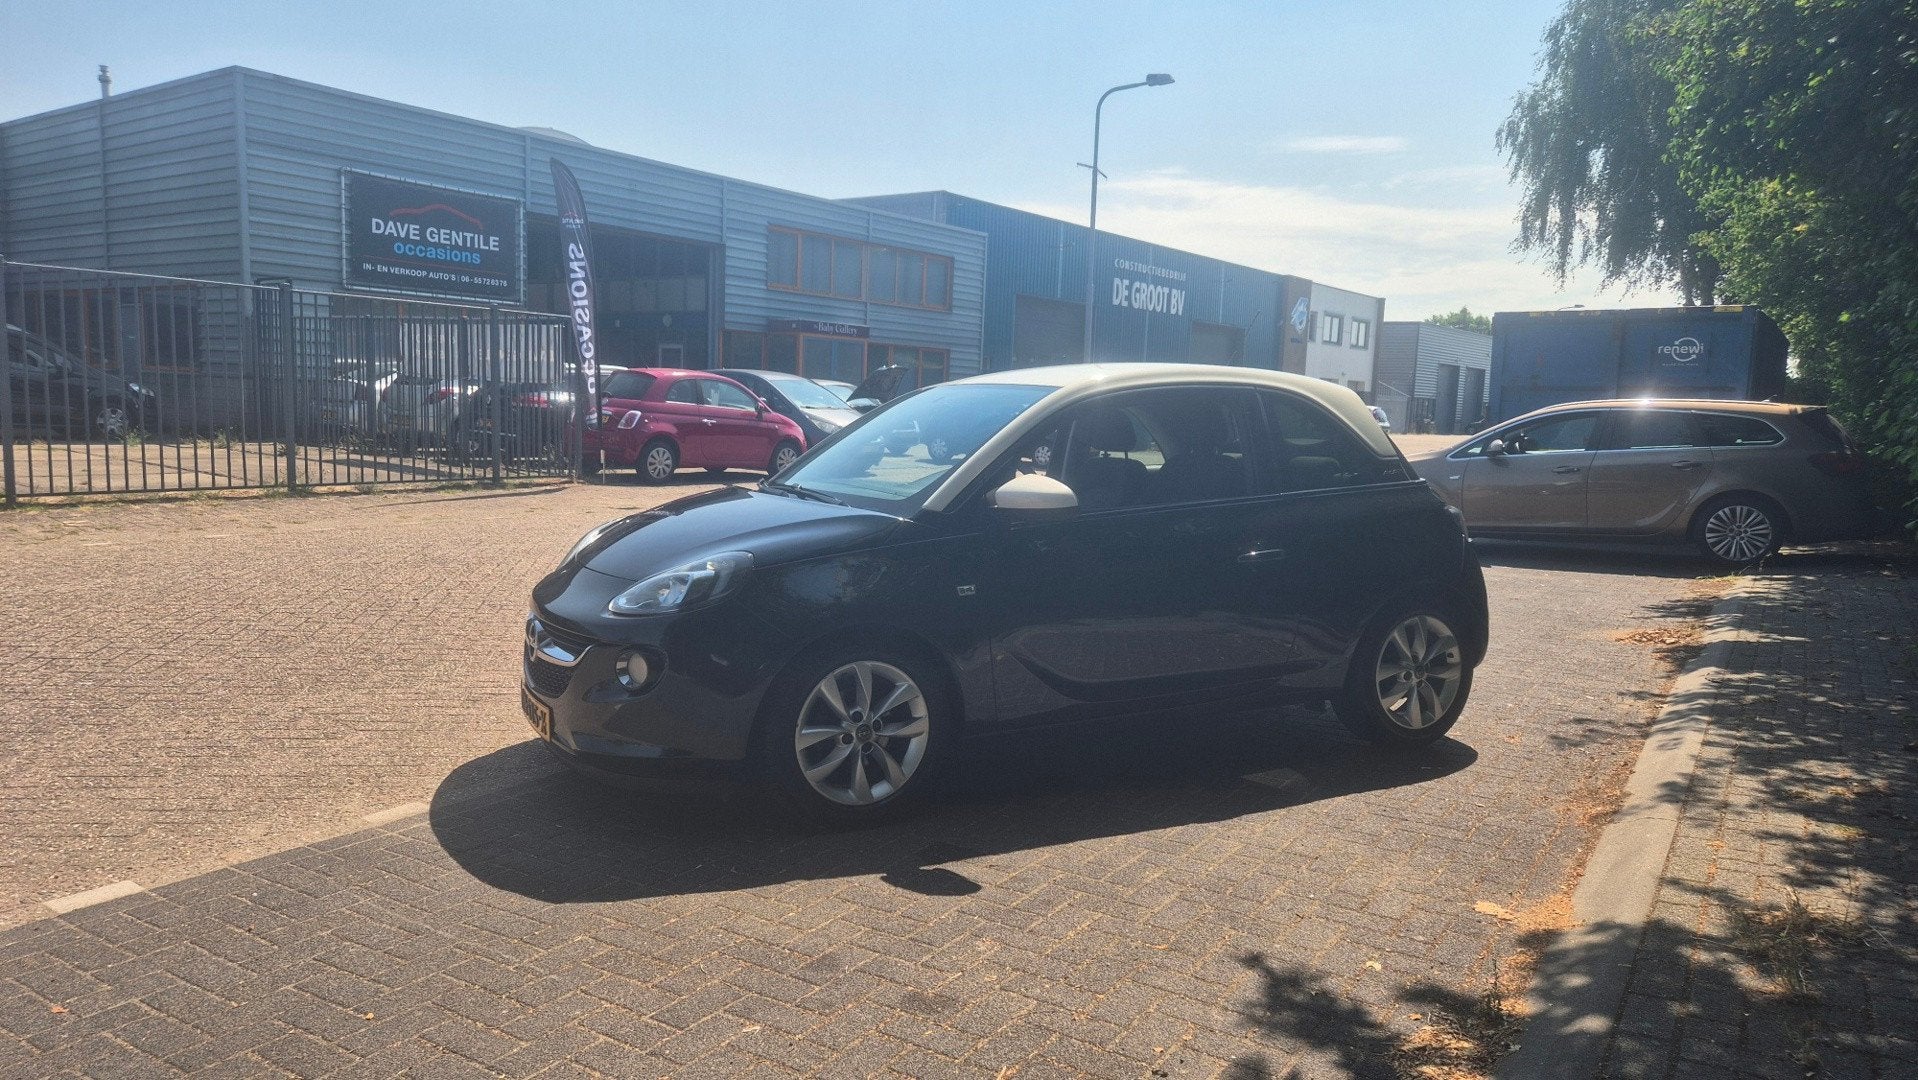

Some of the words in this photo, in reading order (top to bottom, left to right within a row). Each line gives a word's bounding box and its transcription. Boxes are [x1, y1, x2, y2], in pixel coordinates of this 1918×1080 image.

[371, 217, 420, 240] DAVE
[426, 226, 500, 251] GENTILE
[393, 241, 481, 264] occasions
[362, 262, 375, 271] IN-
[377, 264, 388, 272] EN
[390, 266, 428, 277] VERKOOP
[428, 271, 456, 281] AUTO'S
[1112, 277, 1130, 307] DE
[1131, 281, 1169, 313] GROOT
[1170, 288, 1186, 316] BV
[1658, 342, 1704, 356] renewi
